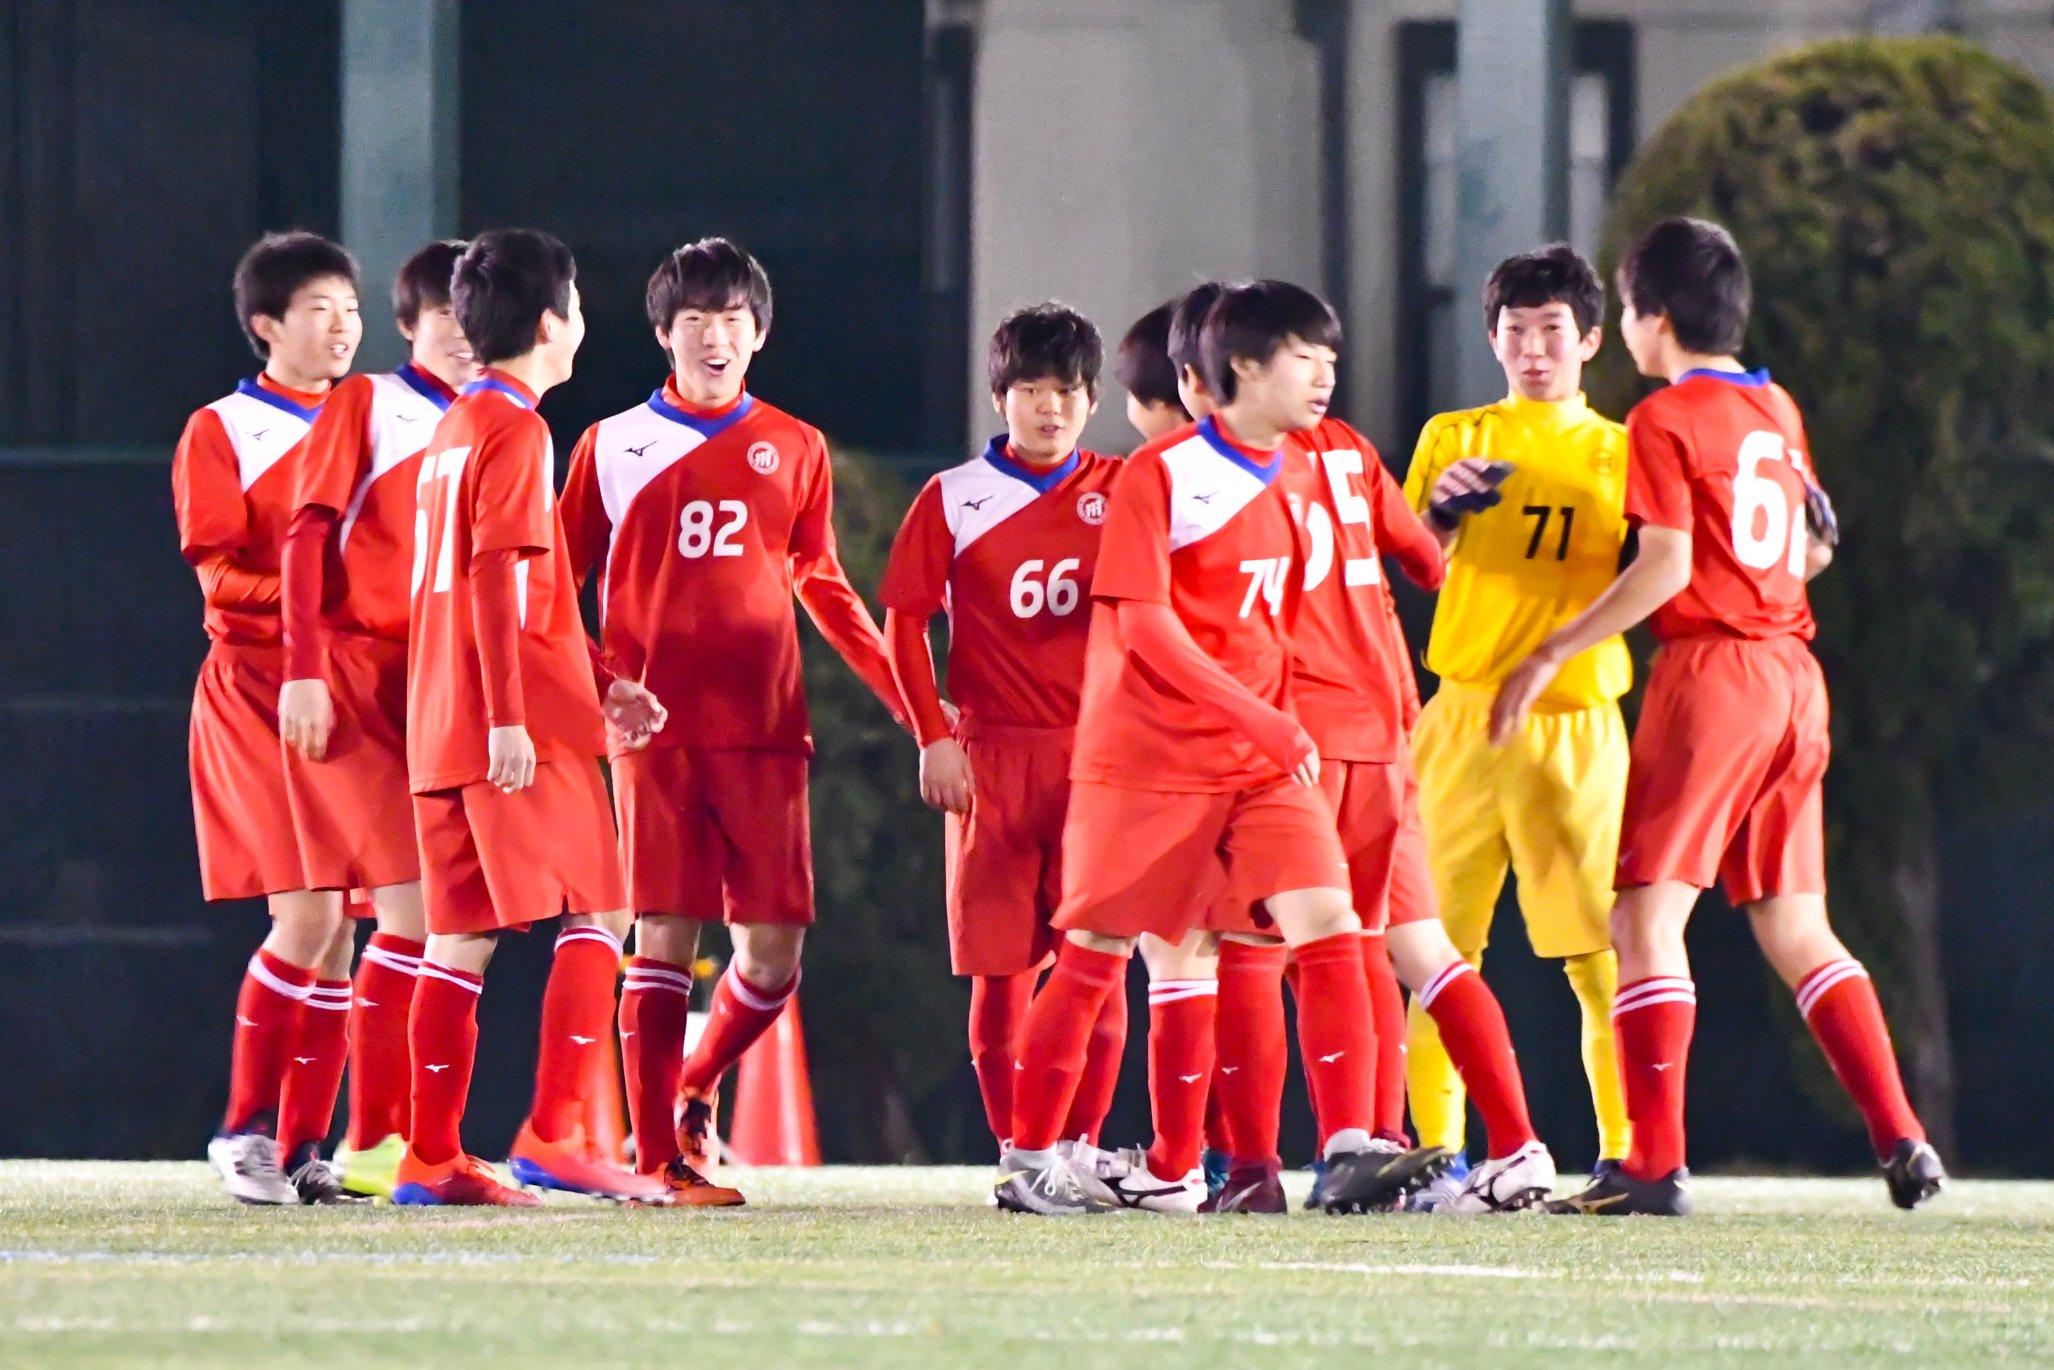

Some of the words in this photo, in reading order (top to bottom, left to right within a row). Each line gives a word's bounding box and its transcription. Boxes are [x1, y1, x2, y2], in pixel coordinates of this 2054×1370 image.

[678, 500, 748, 558] 82
[1522, 506, 1574, 561] 71
[1010, 558, 1079, 618] 66
[1239, 556, 1290, 618] 74
